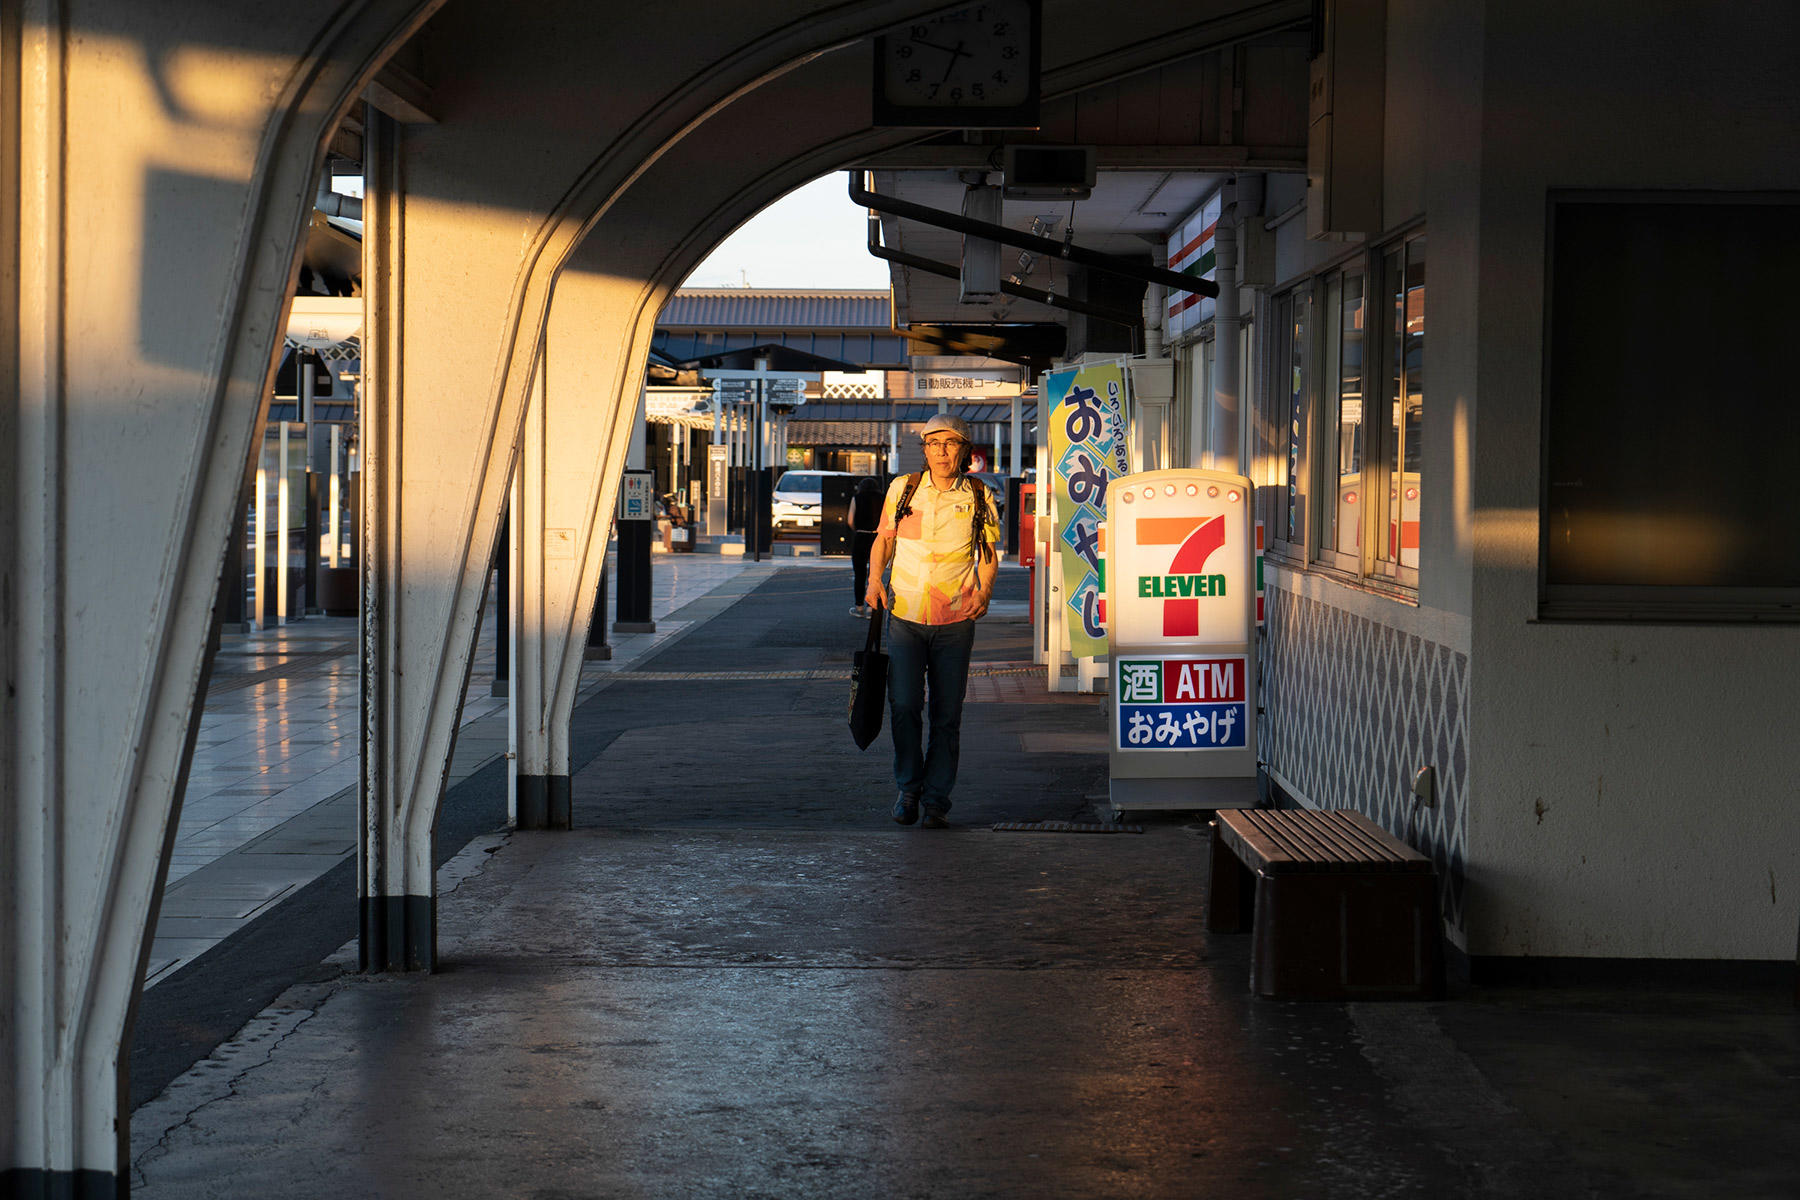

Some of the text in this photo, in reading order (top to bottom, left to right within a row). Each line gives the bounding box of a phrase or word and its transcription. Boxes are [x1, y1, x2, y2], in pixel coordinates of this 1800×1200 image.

[910, 25, 928, 39] 10
[993, 22, 1006, 36] 2
[900, 46, 912, 58] 9
[1002, 46, 1014, 59] 3
[910, 69, 920, 82] 8
[992, 70, 1003, 83] 4
[929, 83, 940, 96] 7
[950, 87, 962, 100] 6
[972, 83, 984, 96] 5
[917, 377, 1018, 390] 自動販売機コーナー
[1107, 381, 1128, 478] いろいろある
[1136, 514, 1225, 636] 7
[1123, 664, 1159, 702] 酒
[1176, 663, 1234, 699] ATM
[1128, 706, 1237, 745] おみやげ
